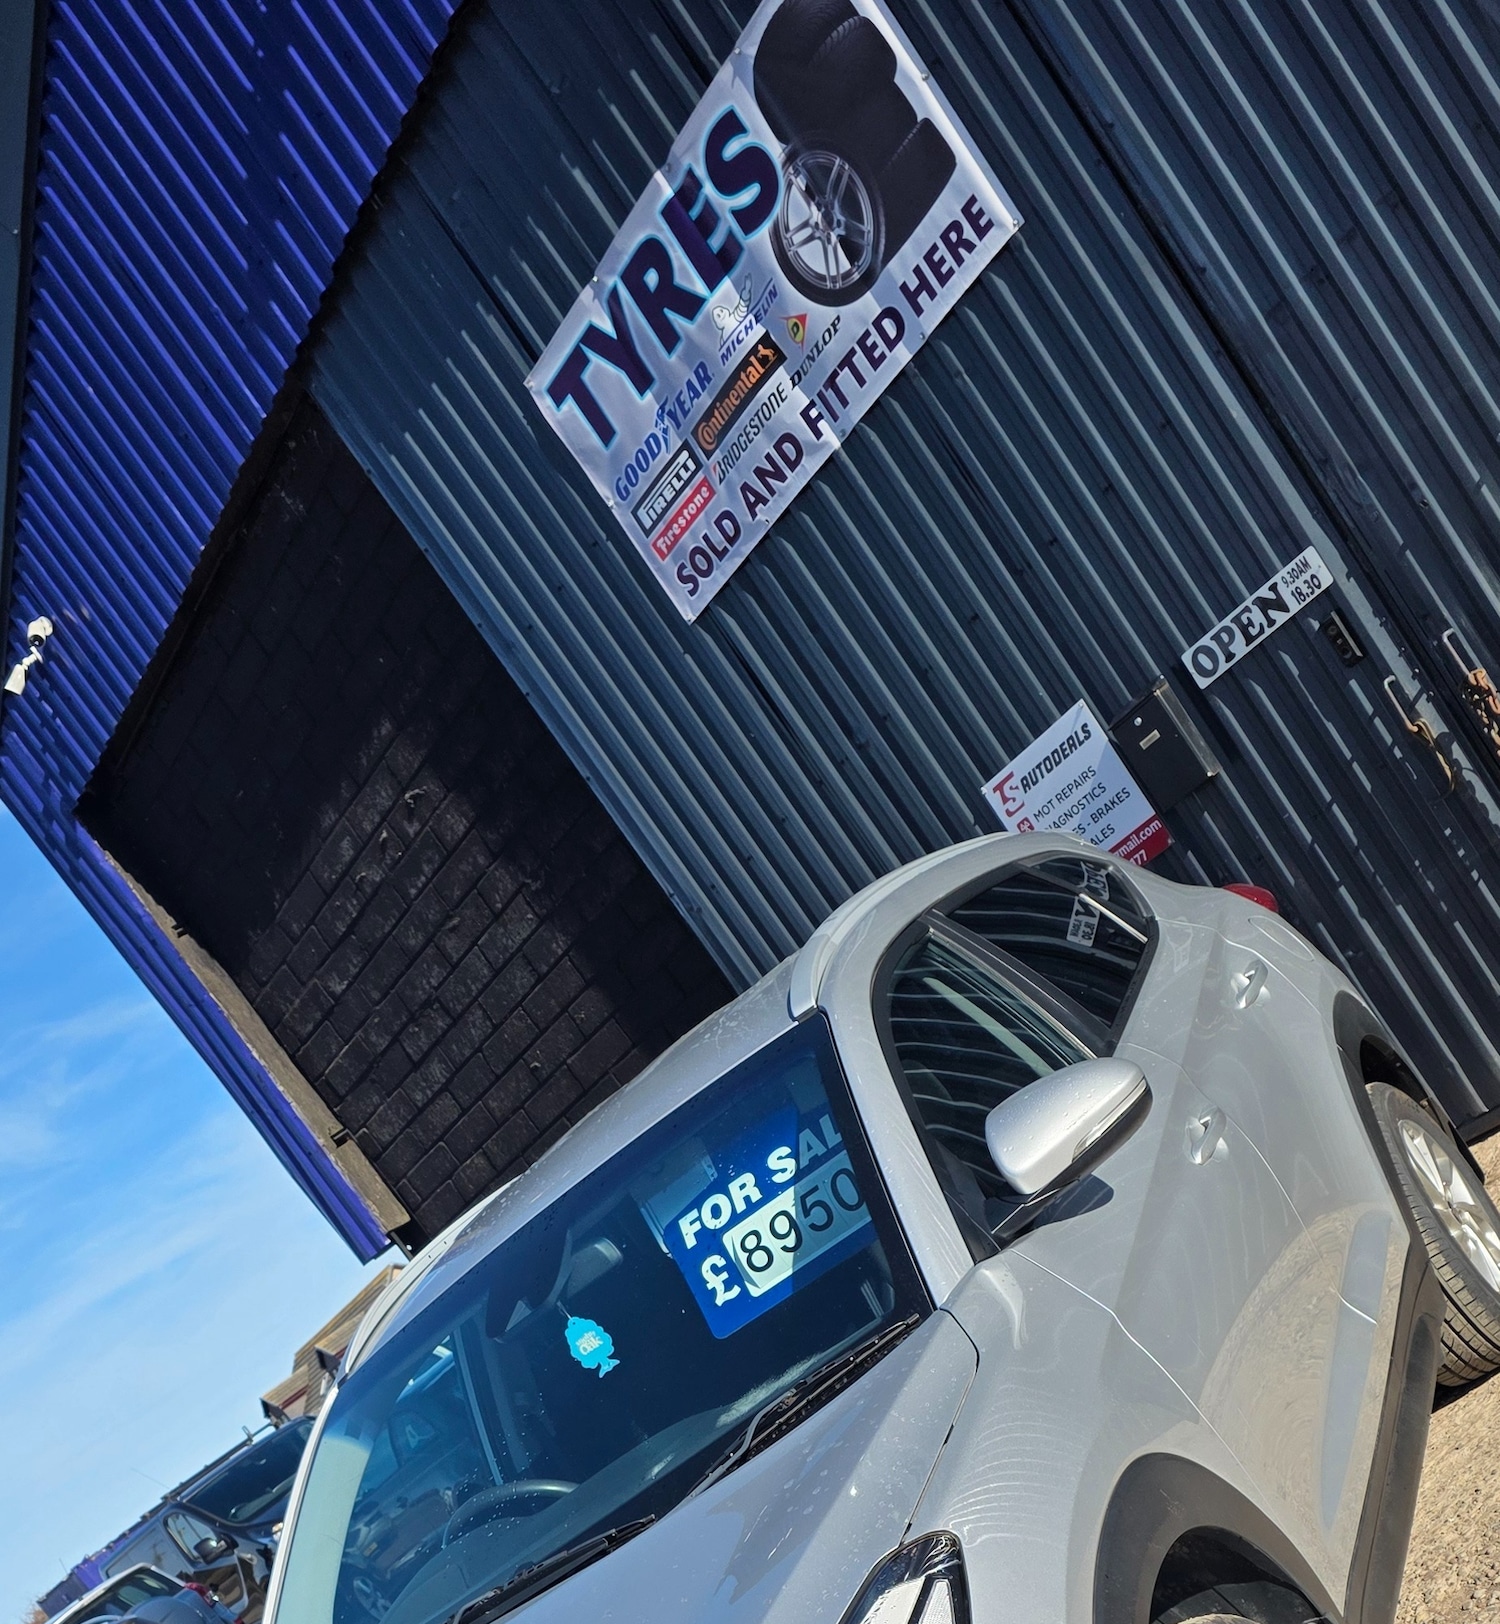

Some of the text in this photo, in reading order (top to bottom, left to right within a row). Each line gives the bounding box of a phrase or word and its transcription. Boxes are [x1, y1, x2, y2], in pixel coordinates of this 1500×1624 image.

[546, 107, 781, 449] TYRES
[720, 284, 778, 367] MICHELIN
[789, 315, 841, 391] DUNLOP
[676, 194, 995, 597] SOLD AND FITTED HERE
[698, 355, 766, 450] Continental
[712, 382, 788, 485] BRIDGESTONE
[637, 450, 697, 530] PIRELLI
[656, 485, 710, 555] Firestone
[1281, 556, 1312, 588] 9.30AM
[1291, 573, 1322, 605] 18.30
[1191, 581, 1290, 678] OPEN
[1020, 722, 1092, 794] AUTODEALS
[1033, 765, 1097, 823] MOT REPAIRS
[1045, 782, 1107, 830] IAGNOSTICS
[1090, 787, 1131, 824] BRAKES
[1090, 823, 1116, 847] ALES
[678, 1113, 843, 1249] FOR SAL
